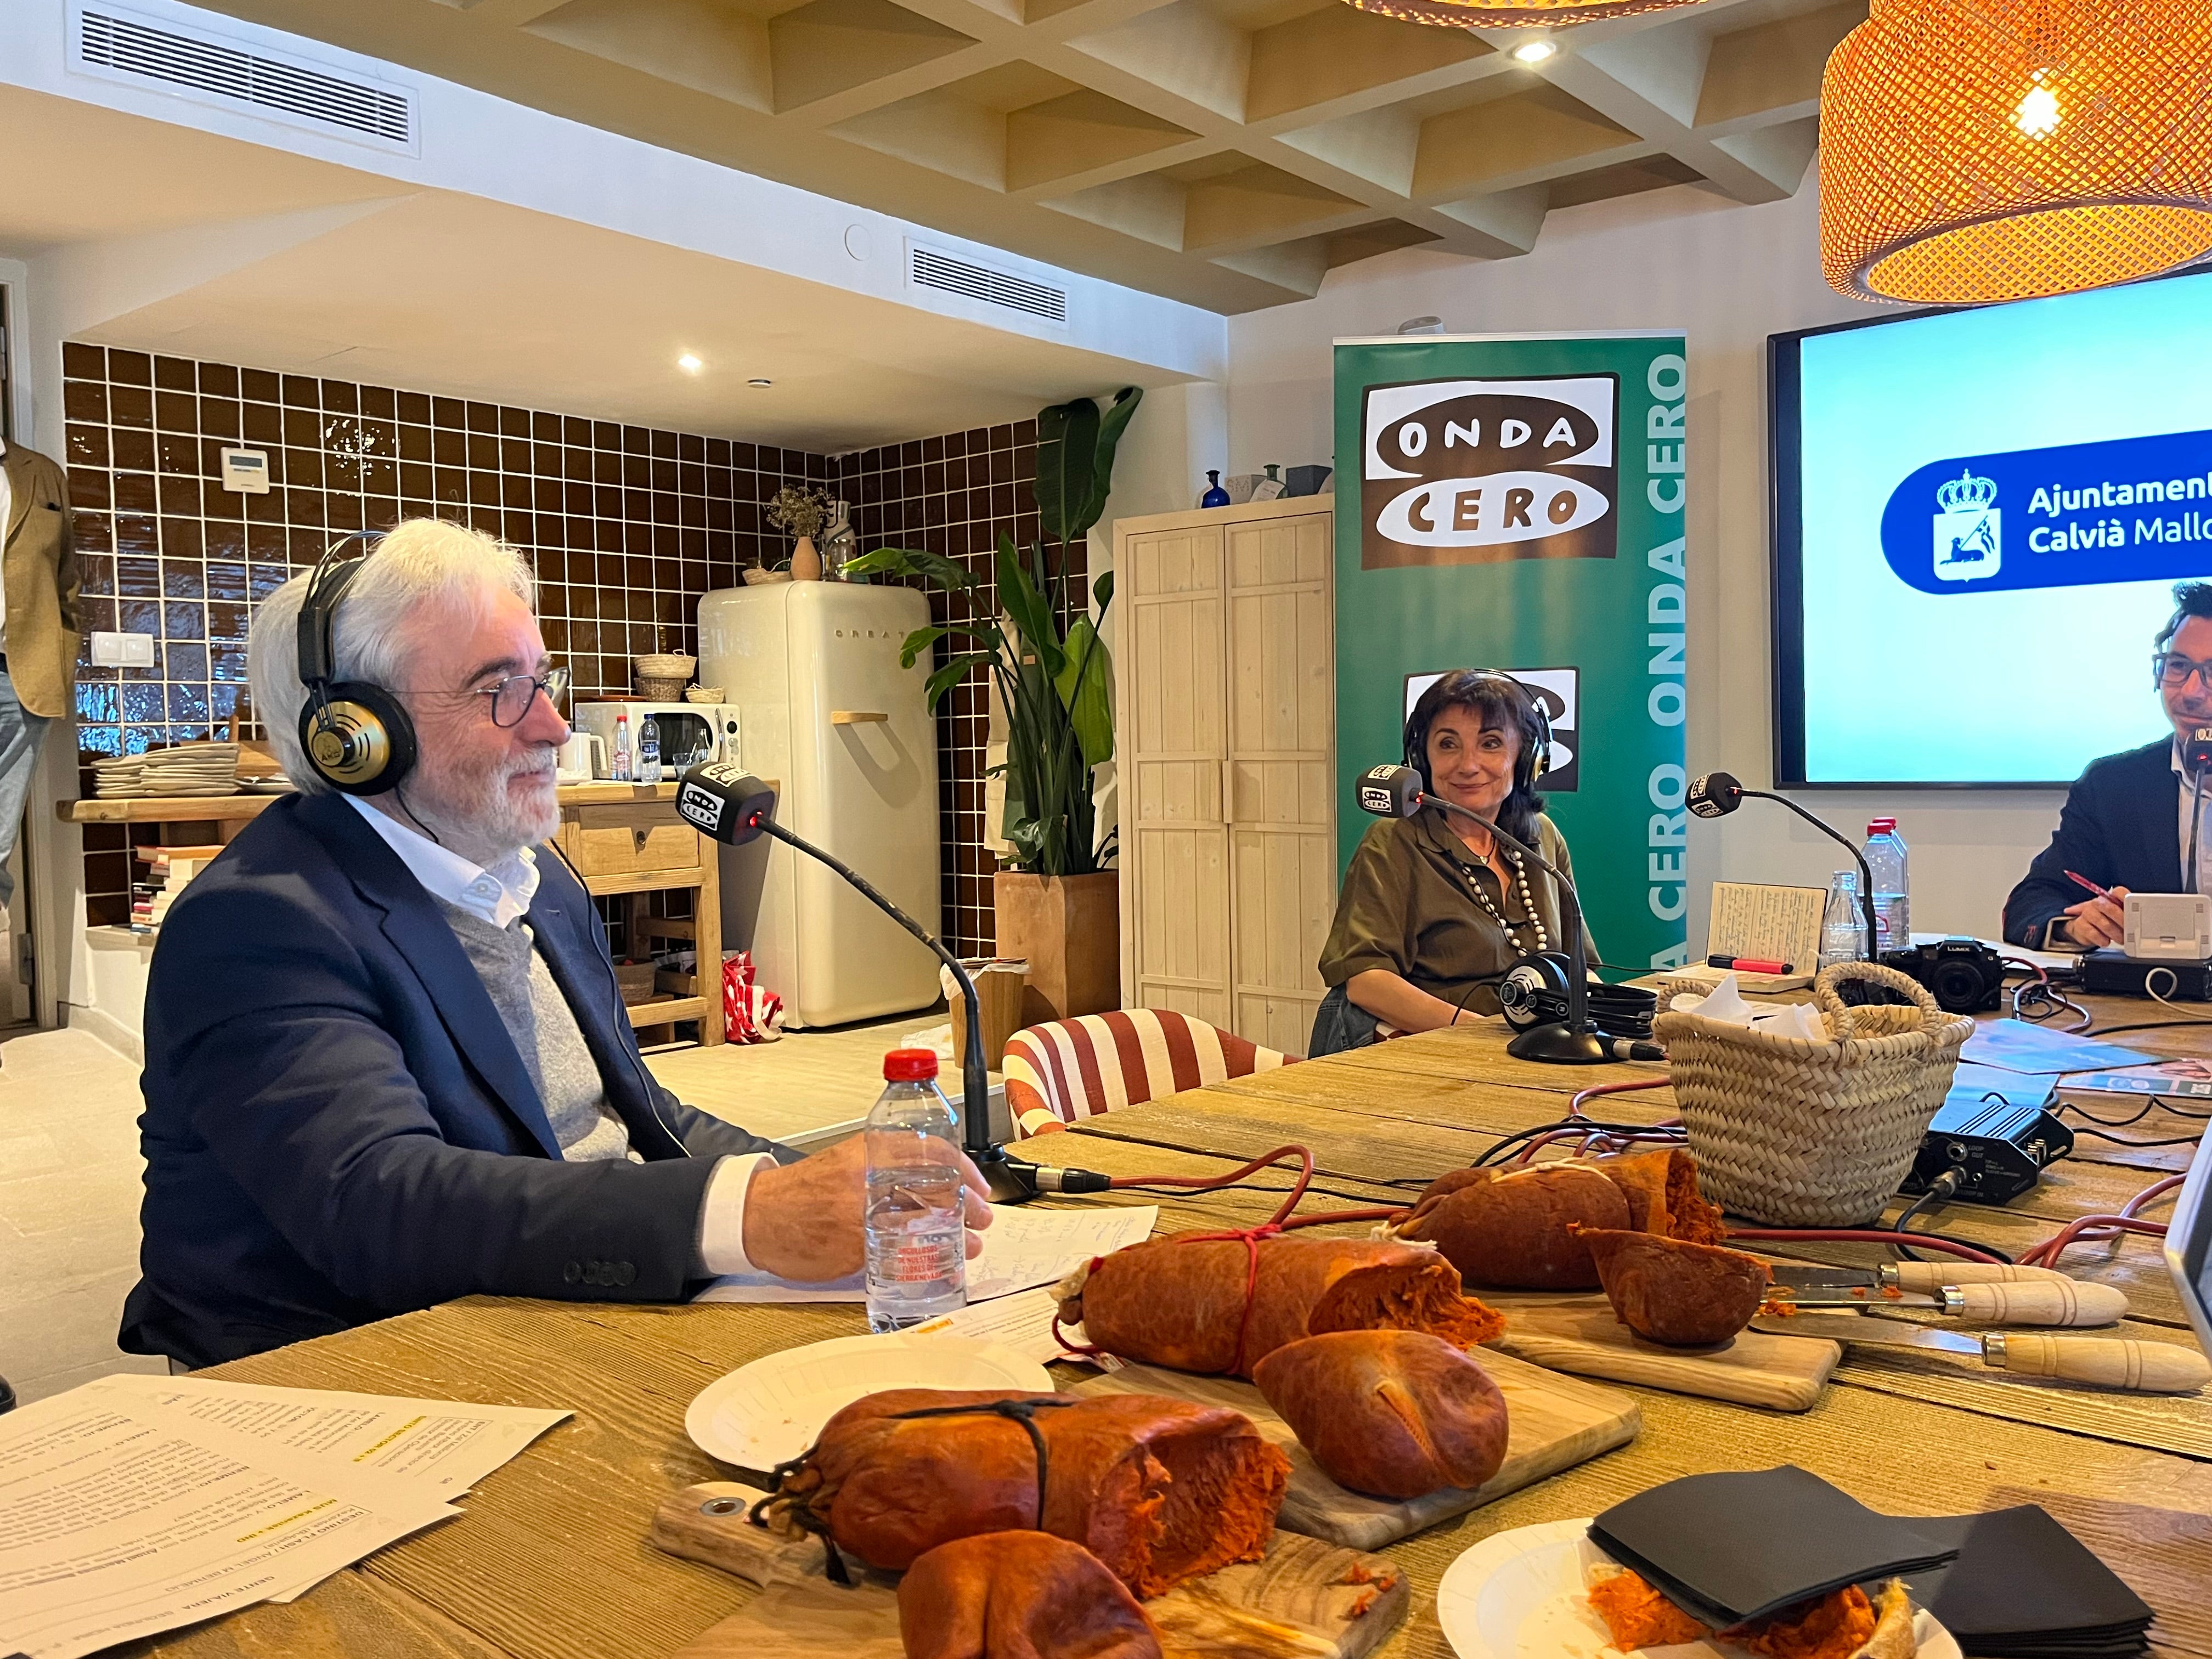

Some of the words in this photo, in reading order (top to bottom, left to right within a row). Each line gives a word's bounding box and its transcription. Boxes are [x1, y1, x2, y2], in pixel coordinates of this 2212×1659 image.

[1399, 417, 1576, 457] ONDA
[1647, 354, 1685, 514] CERO
[1408, 488, 1577, 532] CERO
[2029, 518, 2125, 553] Calvià
[1647, 536, 1686, 727] ONDA
[687, 804, 712, 822] CERO
[688, 792, 715, 809] ONDA
[1647, 763, 1686, 921] CERO
[315, 1511, 365, 1533] DESTINO
[180, 1592, 236, 1610] VIAJERA
[233, 1576, 276, 1592] GENTE
